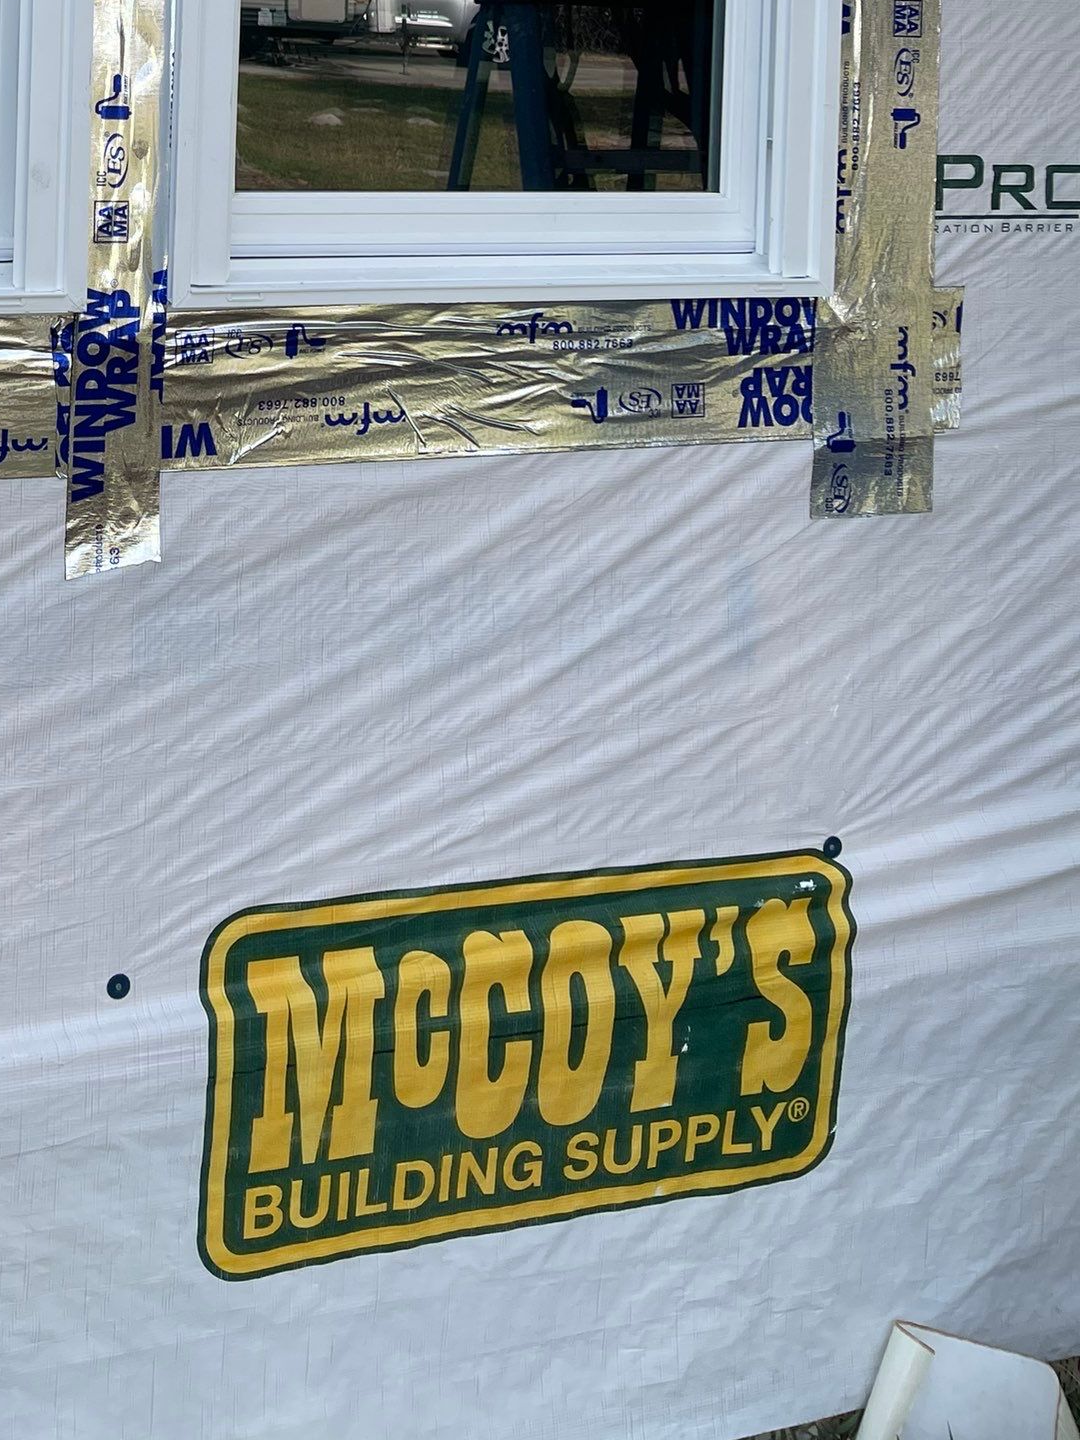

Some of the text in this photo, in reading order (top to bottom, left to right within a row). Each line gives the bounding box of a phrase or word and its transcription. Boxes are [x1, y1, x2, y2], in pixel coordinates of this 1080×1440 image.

[96, 170, 107, 187] ICC
[1001, 222, 1074, 234] BARRIER
[496, 313, 574, 344] mfm
[104, 290, 142, 434] WRAP
[890, 326, 917, 411] mfm
[72, 287, 111, 503] WINDOW
[258, 396, 346, 410] 800.882.7663
[324, 402, 407, 436] mfm
[242, 1140, 543, 1241] BUILDING
